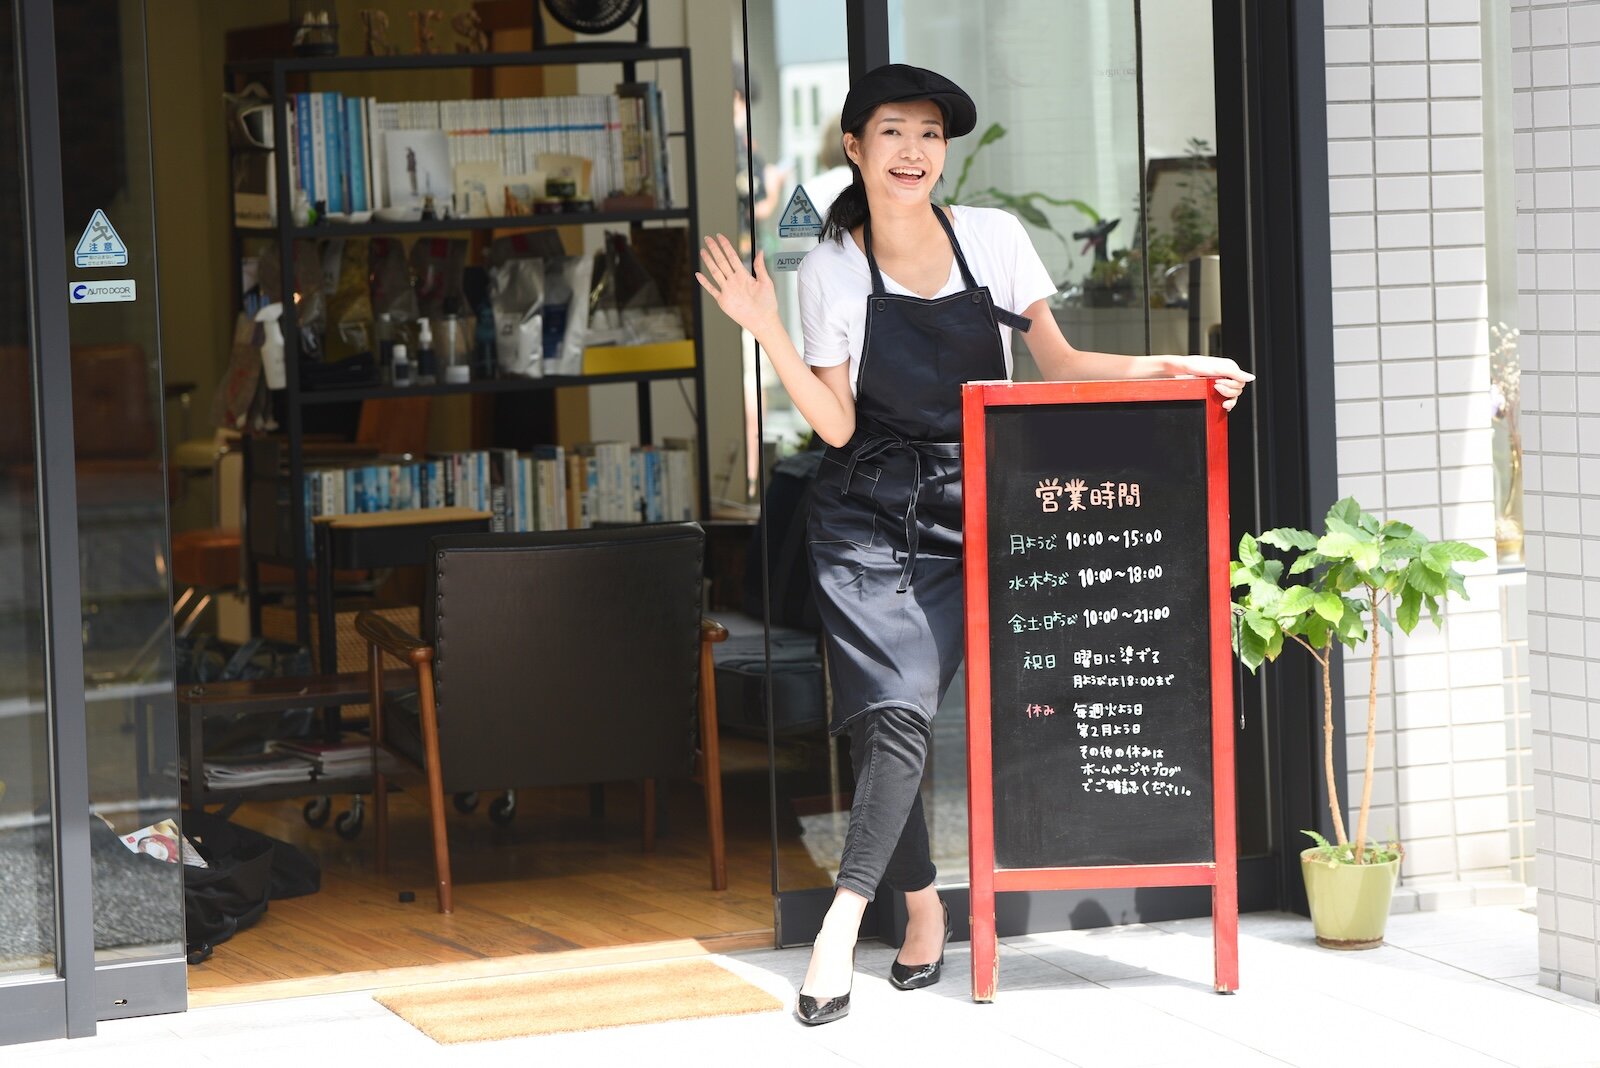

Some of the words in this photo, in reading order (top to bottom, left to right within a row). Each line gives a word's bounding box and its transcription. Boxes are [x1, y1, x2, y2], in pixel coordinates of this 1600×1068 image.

[791, 215, 811, 223] 注意
[89, 242, 112, 251] 注意
[87, 287, 108, 295] AUTO
[109, 286, 131, 295] DOOR
[1035, 477, 1141, 513] 営業時間
[1009, 533, 1057, 555] 月ようび
[1023, 650, 1056, 670] 祝日
[1072, 673, 1175, 689] 月ようびは18:00まで
[1025, 703, 1055, 719] 休み
[1072, 702, 1143, 720] 毎週火よう日
[1076, 722, 1141, 739] 第2月よう日
[1079, 744, 1164, 760] その他の休みは
[1079, 761, 1182, 778] ホームページやブログ
